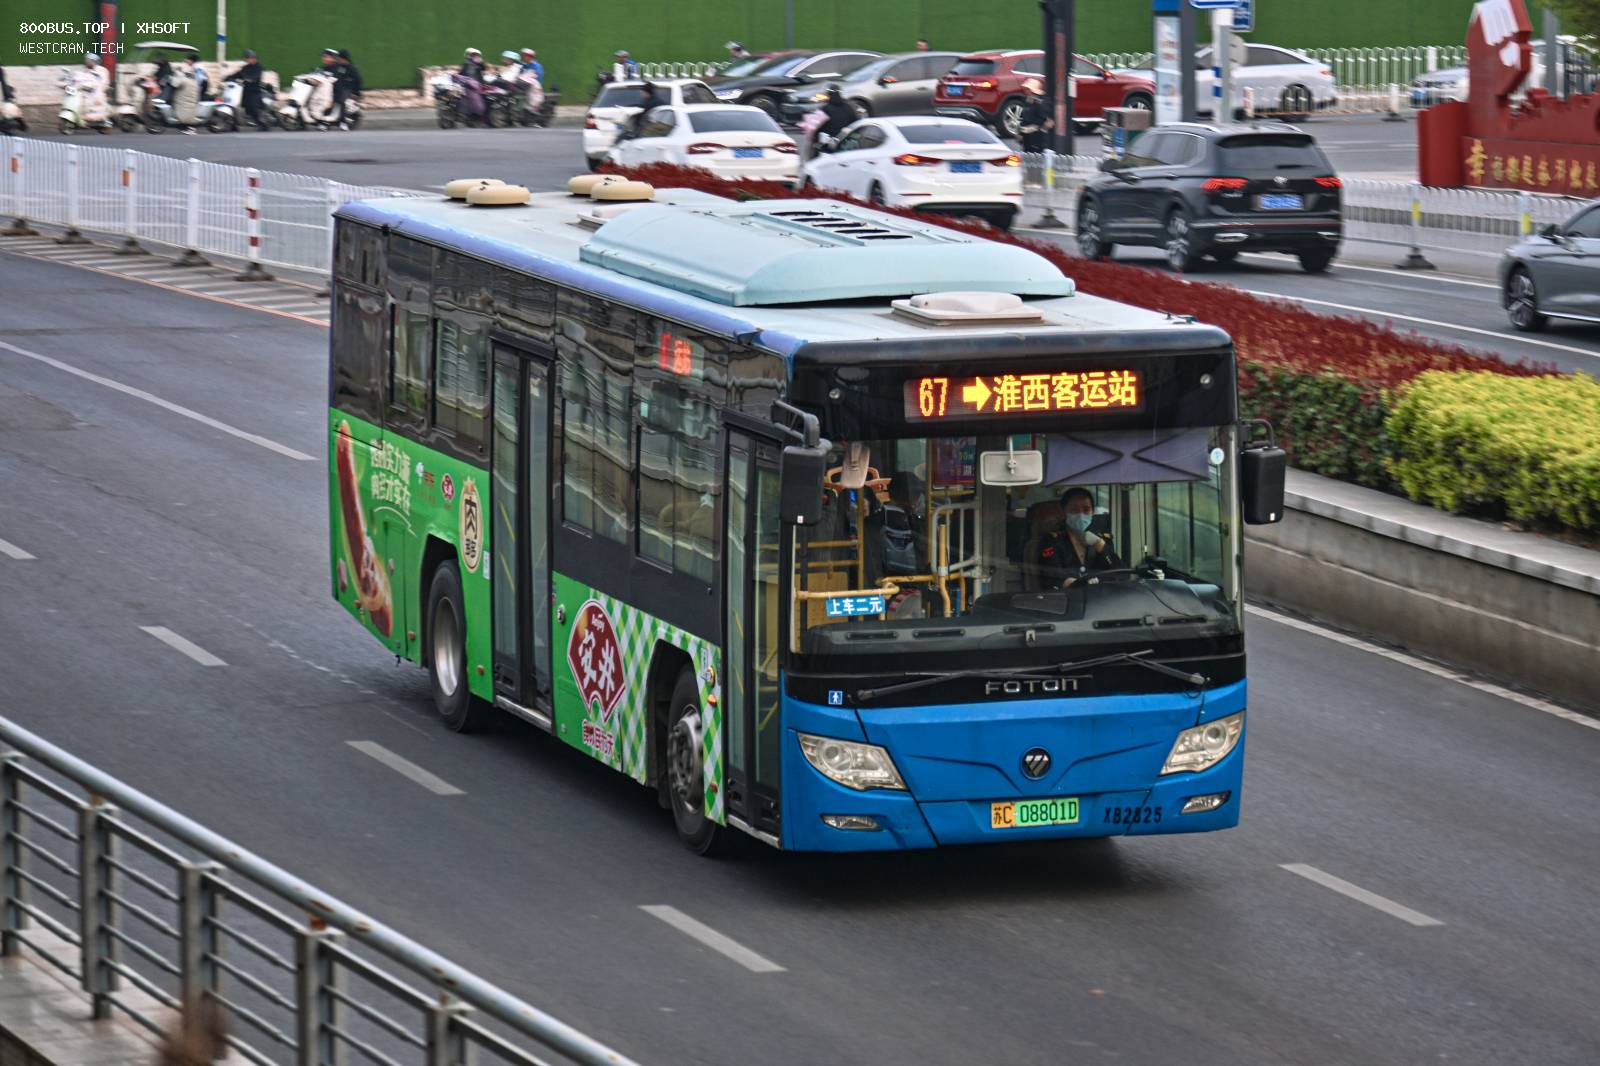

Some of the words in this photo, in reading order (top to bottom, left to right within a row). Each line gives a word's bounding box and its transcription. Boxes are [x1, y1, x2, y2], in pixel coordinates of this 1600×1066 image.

[919, 378, 948, 417] 67
[993, 370, 1137, 412] 淮西客运站
[829, 595, 884, 616] 上车二元
[985, 678, 1078, 696] FOTON
[1104, 806, 1163, 825] XB2825
